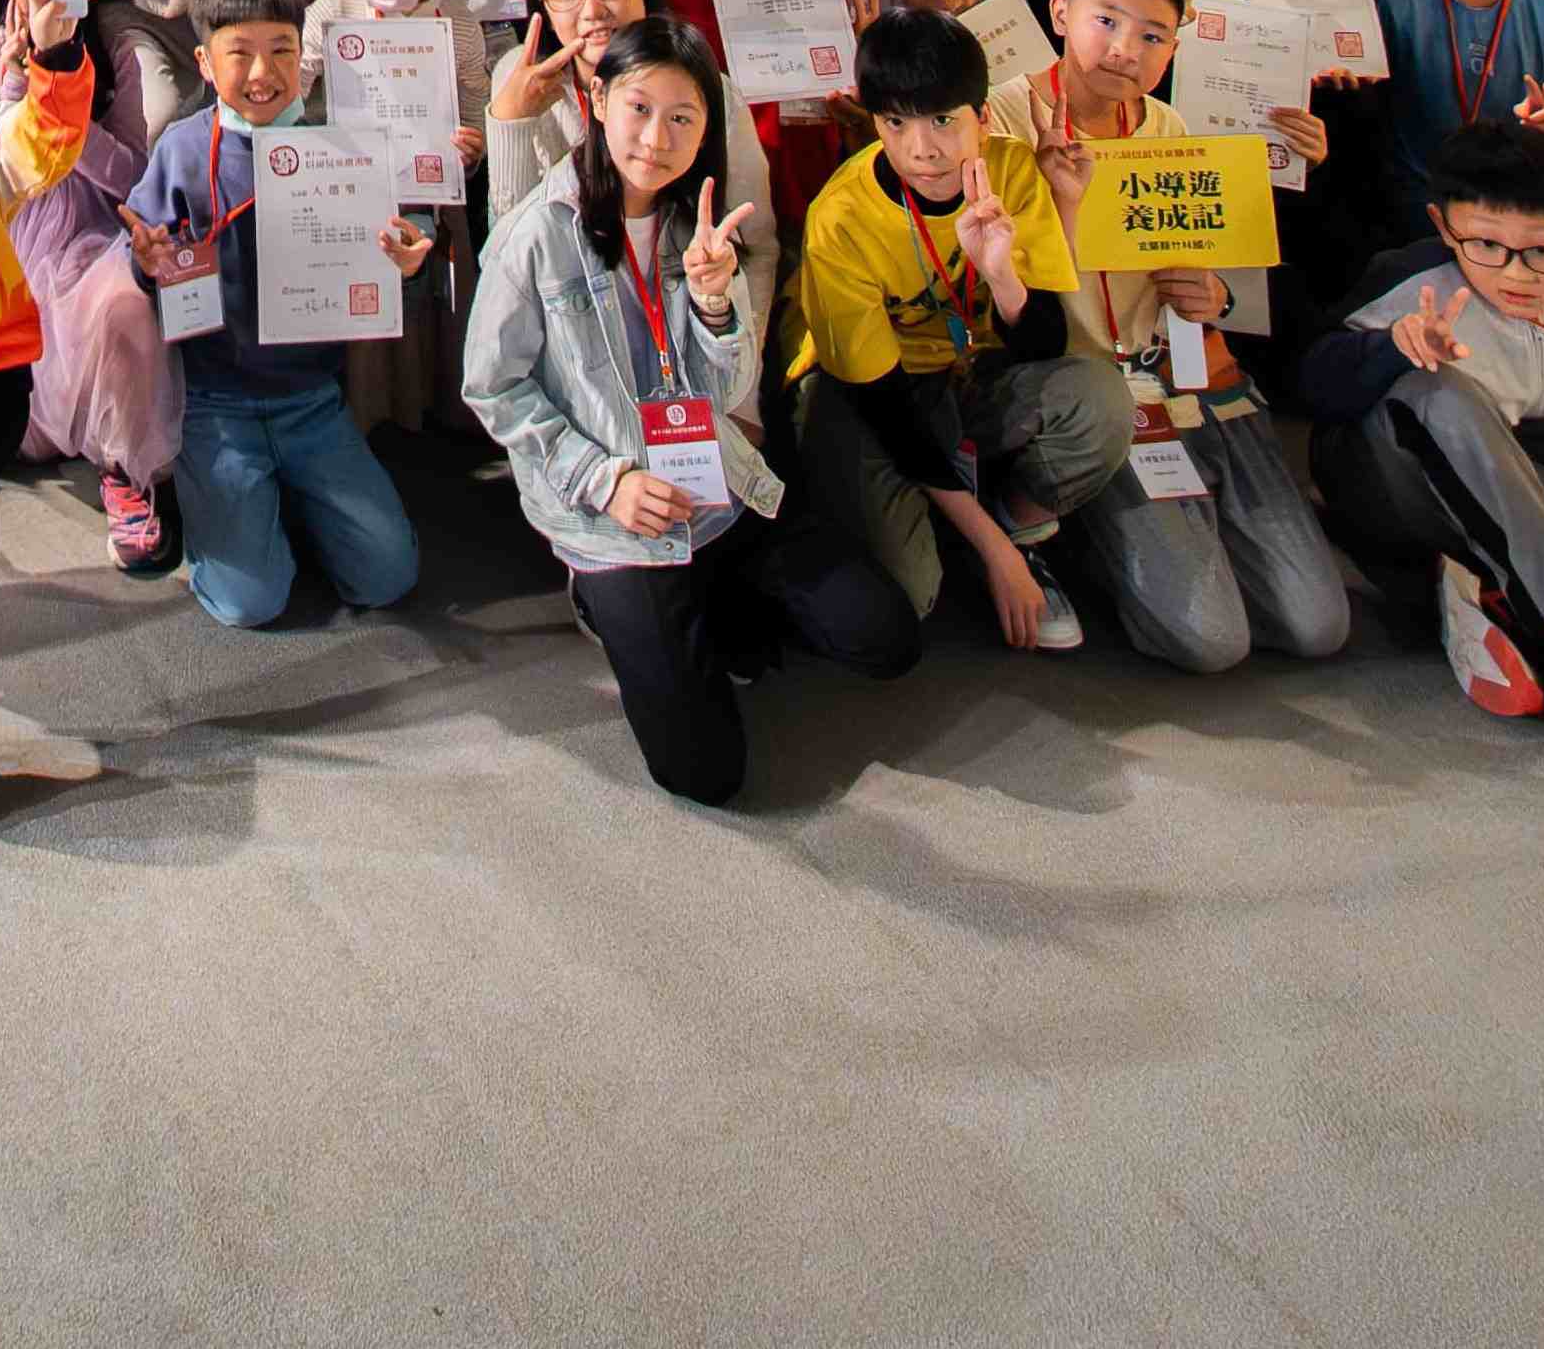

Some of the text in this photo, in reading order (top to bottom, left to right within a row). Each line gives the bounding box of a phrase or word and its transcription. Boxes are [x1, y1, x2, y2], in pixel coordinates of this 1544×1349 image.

[1118, 171, 1222, 201] 小導遊
[1122, 202, 1226, 234] 養成記
